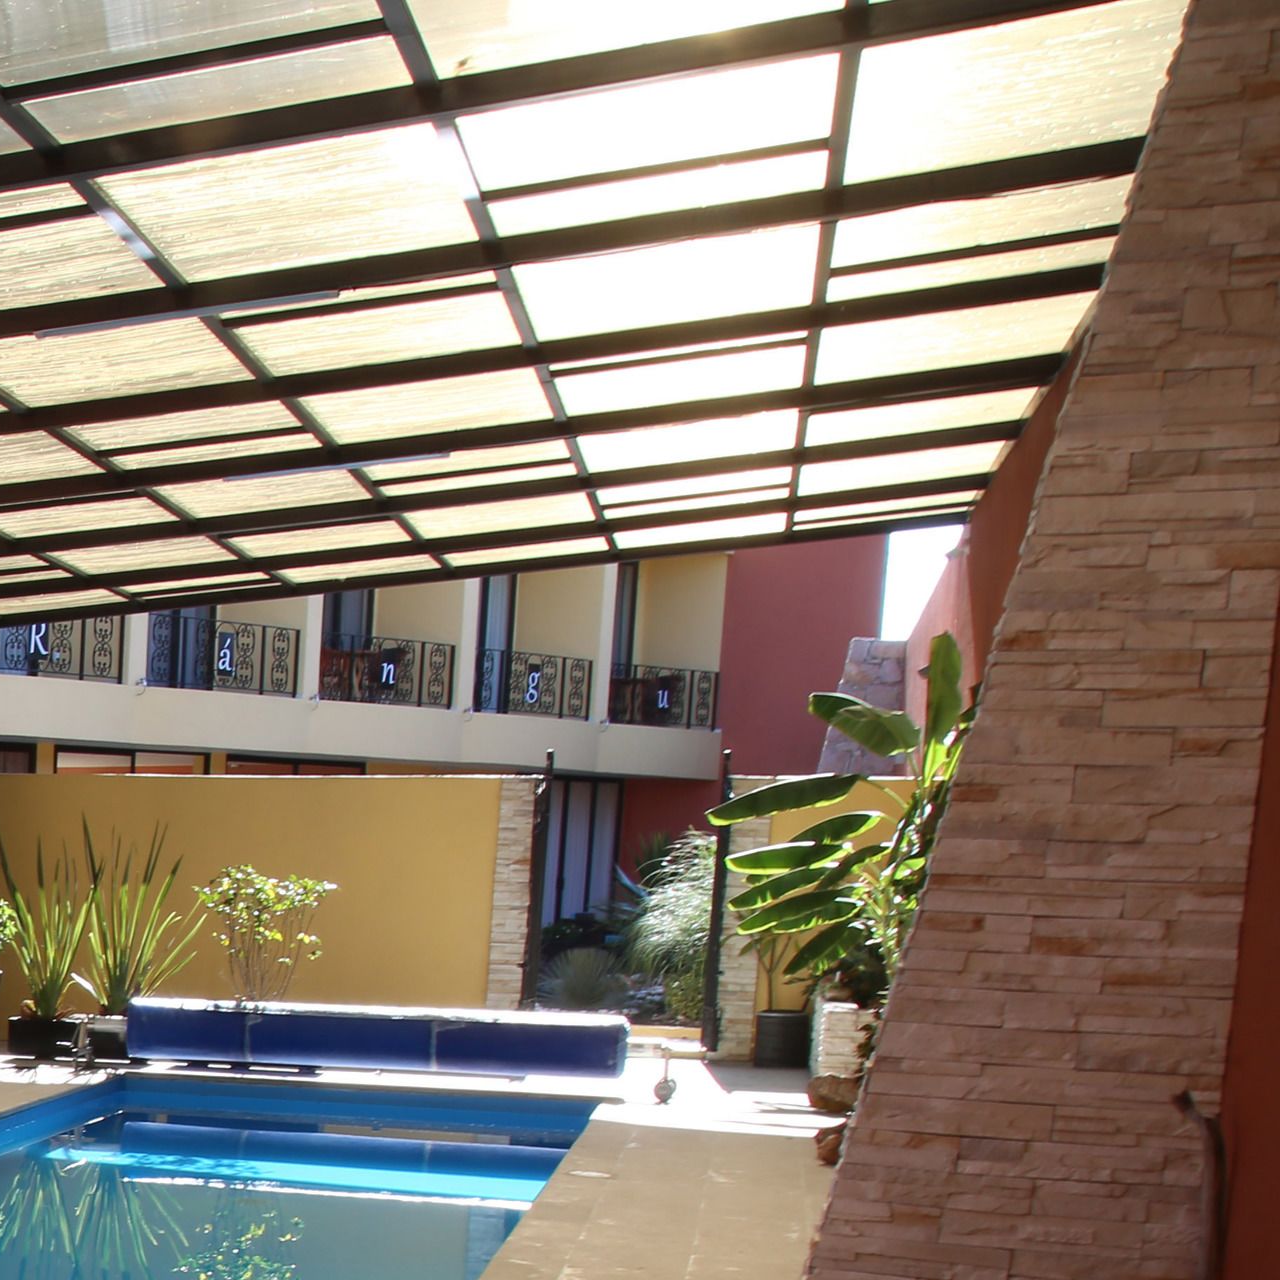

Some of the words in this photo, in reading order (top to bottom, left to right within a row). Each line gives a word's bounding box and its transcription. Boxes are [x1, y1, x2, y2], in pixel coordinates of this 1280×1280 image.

[29, 622, 49, 655] R
[218, 637, 233, 671] á
[381, 662, 395, 684] n
[527, 671, 541, 704] g
[657, 690, 670, 709] u
